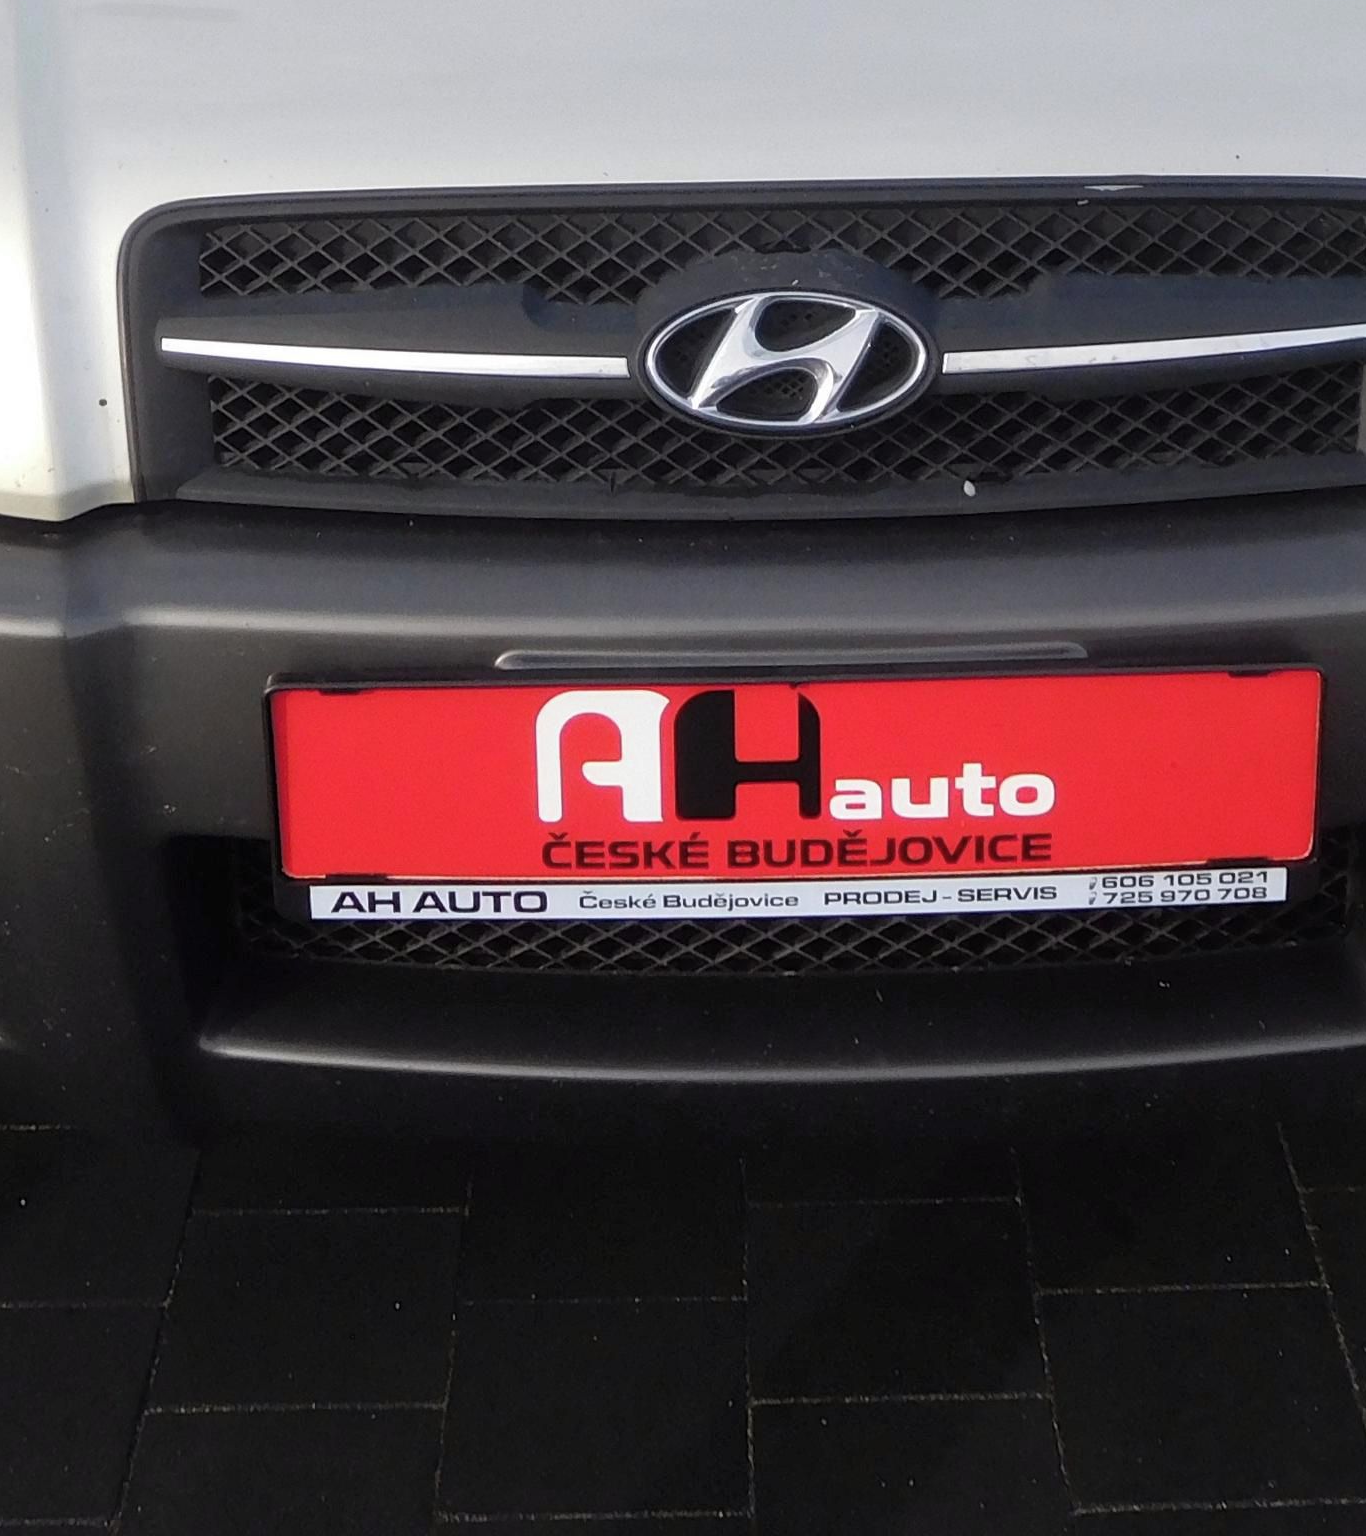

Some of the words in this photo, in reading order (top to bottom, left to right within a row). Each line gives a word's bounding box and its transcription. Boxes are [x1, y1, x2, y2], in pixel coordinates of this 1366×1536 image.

[541, 831, 709, 870] ČESKÉ
[727, 829, 1053, 868] BUDĚJOVICE
[1102, 875, 1155, 889] 606
[1163, 873, 1212, 886] 105
[1219, 871, 1268, 884] 021
[331, 891, 401, 913] AH
[413, 891, 548, 913] AUTO
[579, 891, 656, 909] České
[663, 893, 799, 911] Budějovice
[824, 890, 937, 905] PRODEJ
[957, 886, 1057, 902] SERVIS
[1102, 891, 1153, 904] 725
[1160, 889, 1211, 902] 970
[1217, 887, 1268, 900] 708
